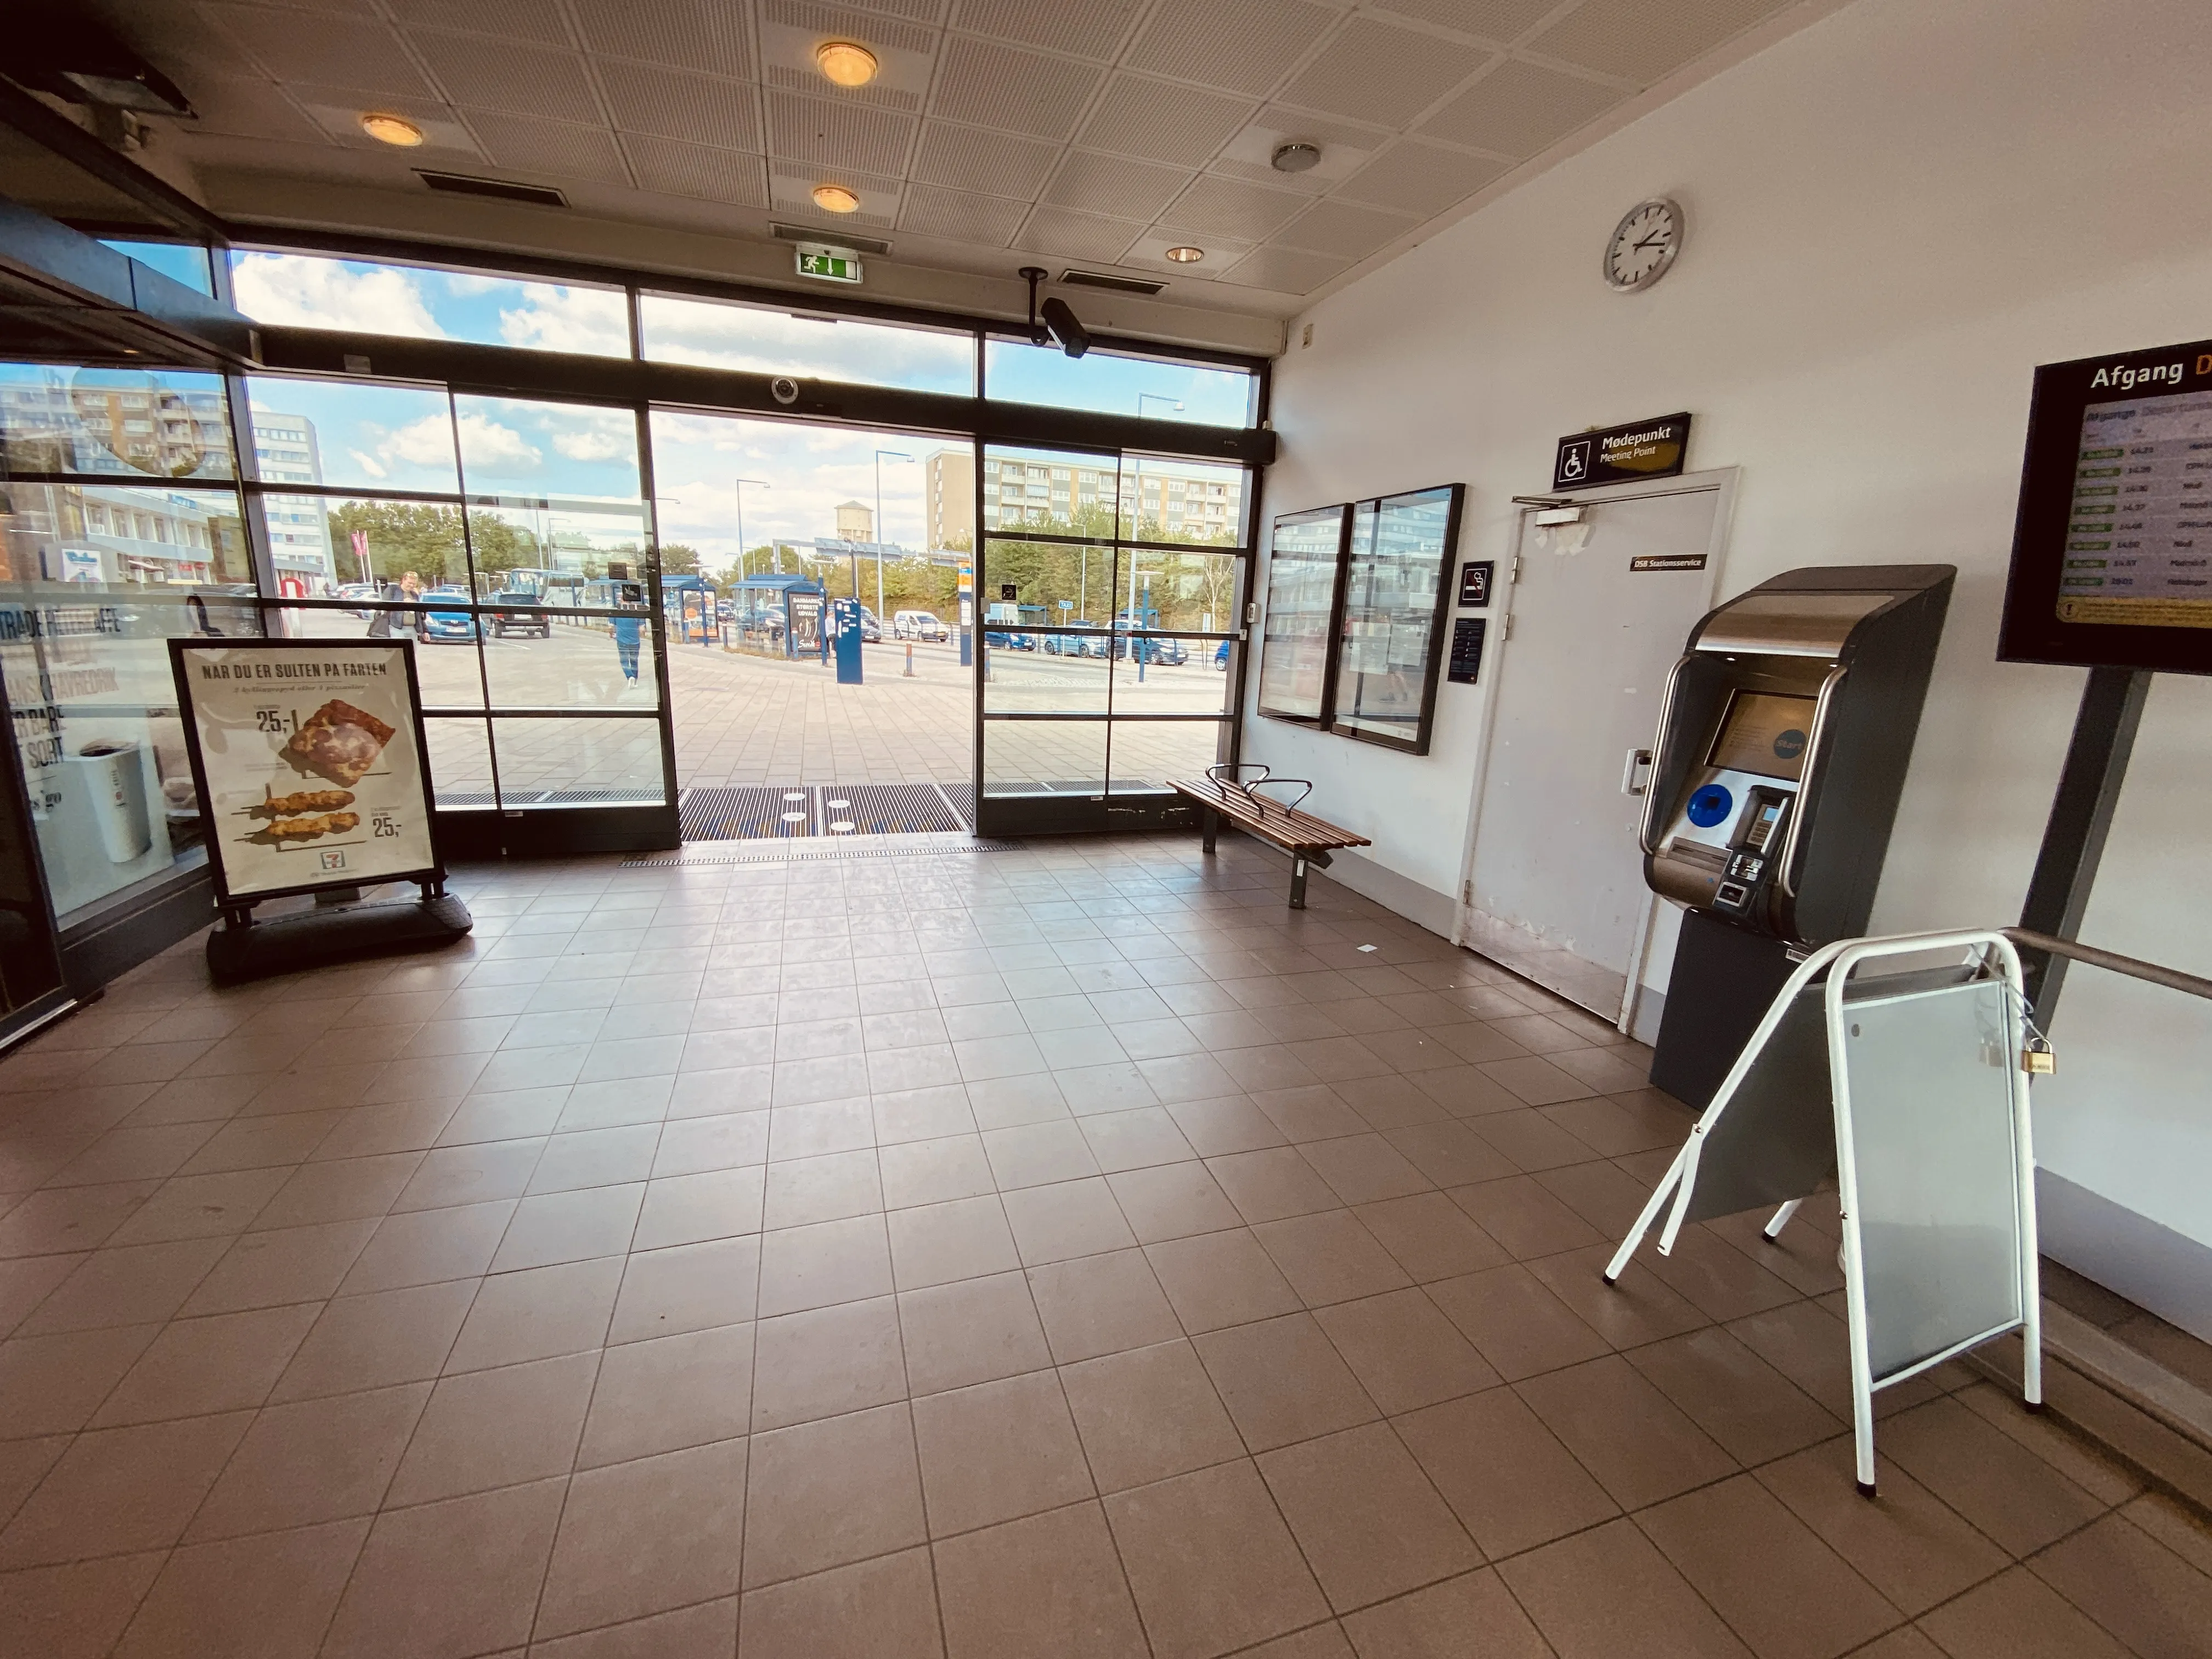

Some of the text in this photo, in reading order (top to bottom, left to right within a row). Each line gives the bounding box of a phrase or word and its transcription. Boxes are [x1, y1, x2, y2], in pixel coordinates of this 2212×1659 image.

[2090, 363, 2184, 390] Afgang
[1602, 426, 1672, 450] Mødepunkt
[1600, 446, 1656, 463] Meeting Point
[1649, 558, 1701, 568] Stationsservice
[233, 664, 252, 679] DU
[255, 664, 272, 679] ER
[275, 663, 320, 678] SULTEN
[343, 663, 387, 676] FARTEN
[256, 710, 290, 734] 25,-
[27, 736, 64, 769] SORT
[373, 817, 402, 838] 25,-
